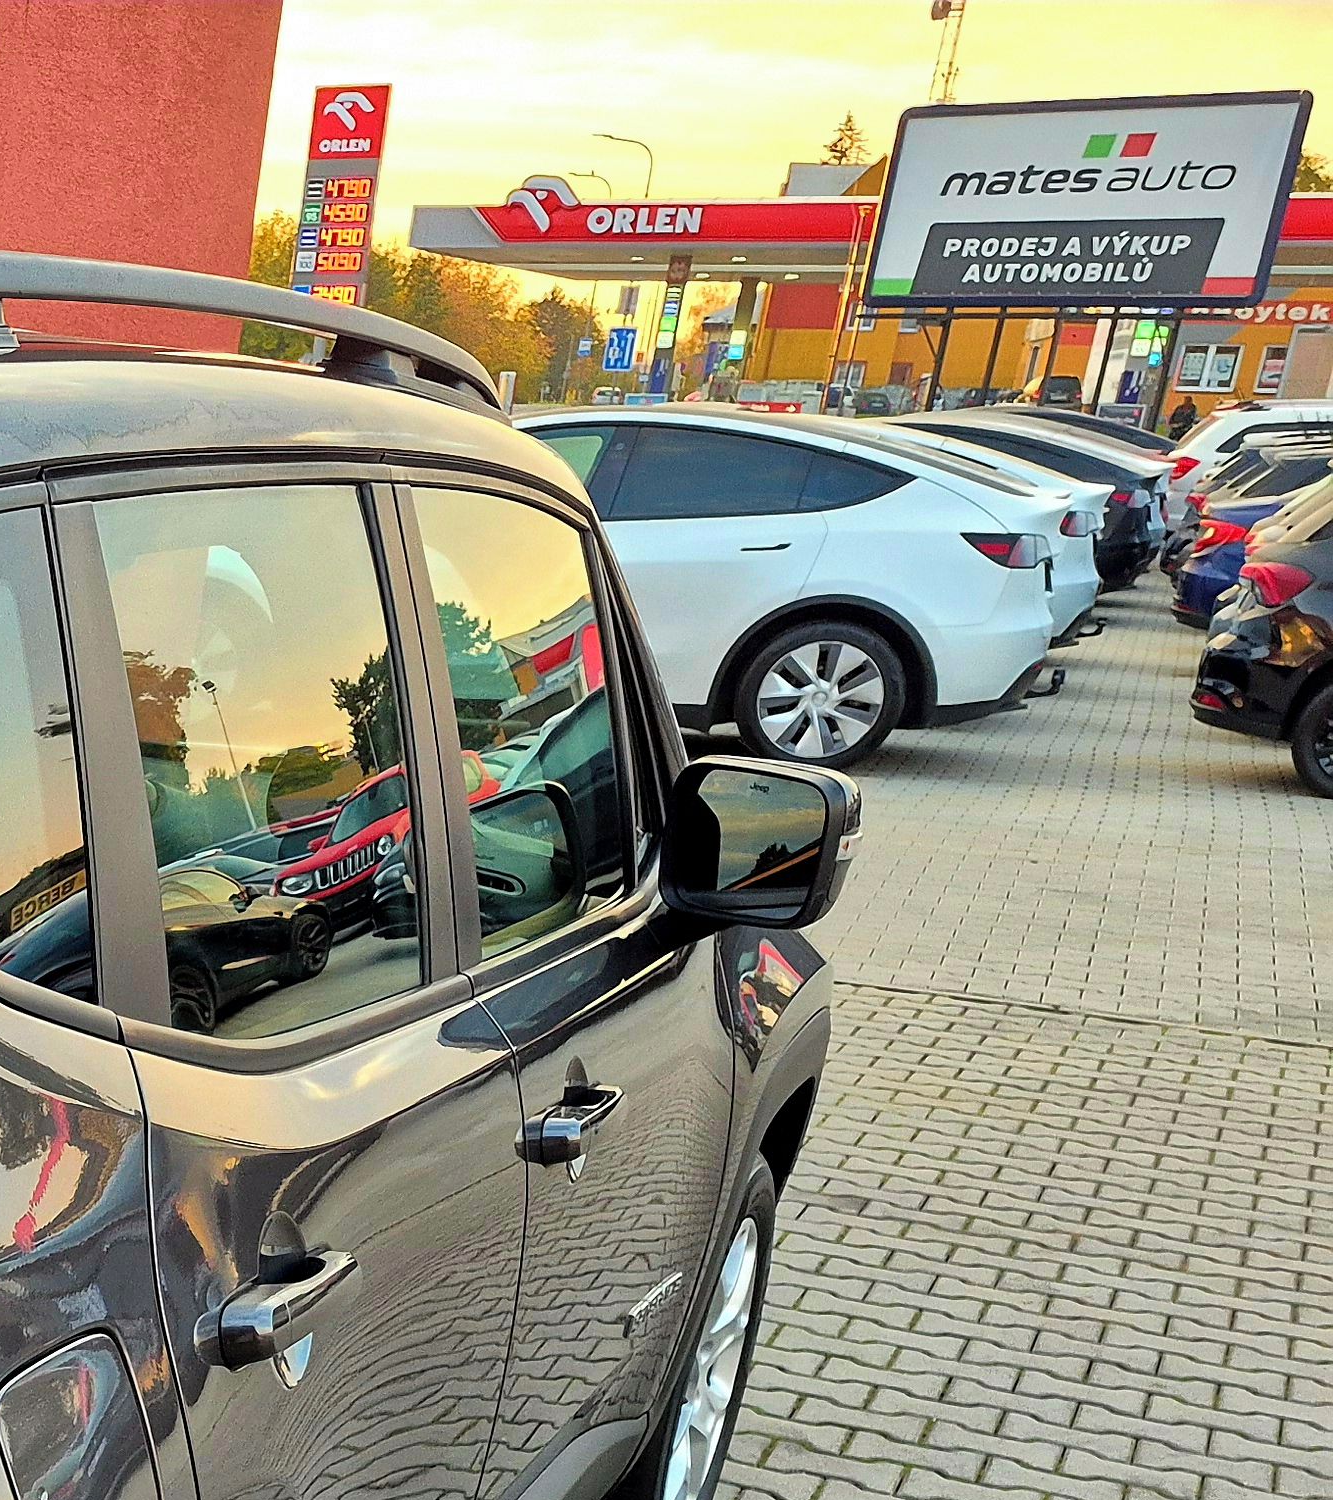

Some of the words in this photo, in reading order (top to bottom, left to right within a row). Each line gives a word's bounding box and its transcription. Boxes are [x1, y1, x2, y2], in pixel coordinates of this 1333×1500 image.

[318, 138, 371, 152] ORLEN
[586, 207, 703, 234] ORLEN
[941, 236, 1059, 258] PRODEJ
[1060, 237, 1082, 257] A
[1091, 230, 1192, 256] VÝKUP
